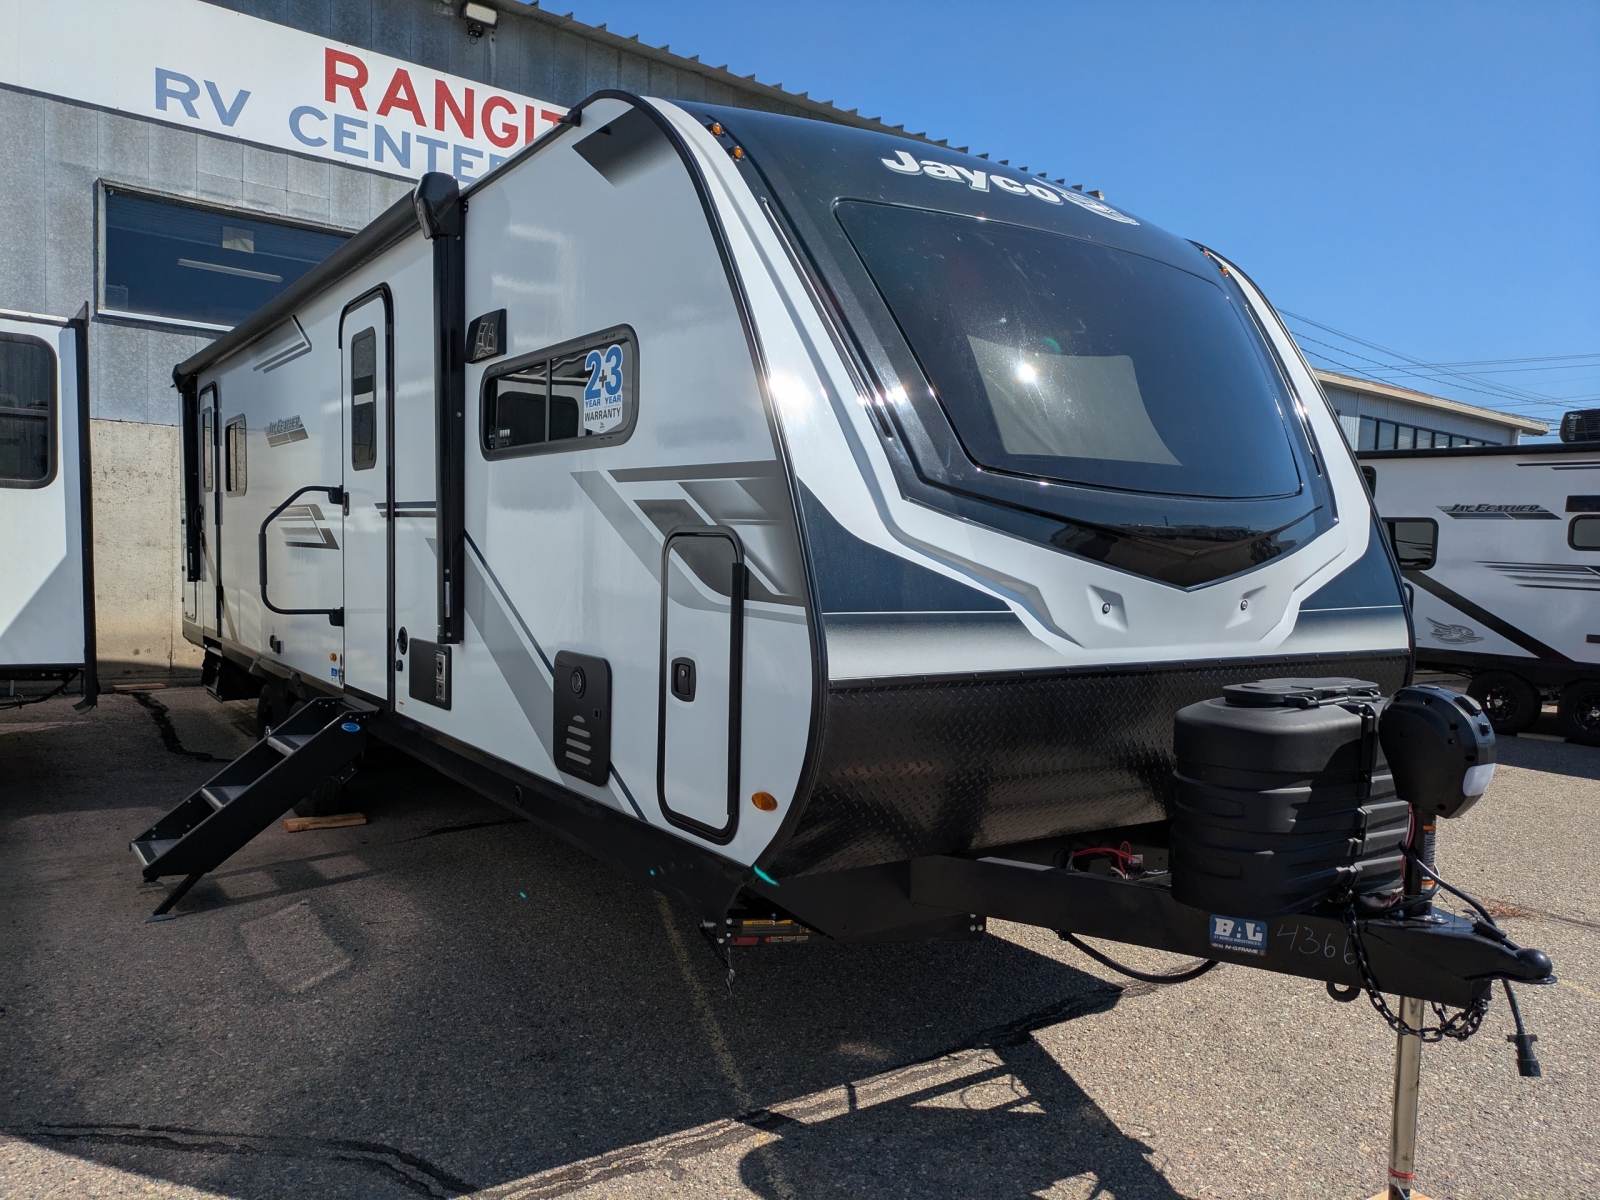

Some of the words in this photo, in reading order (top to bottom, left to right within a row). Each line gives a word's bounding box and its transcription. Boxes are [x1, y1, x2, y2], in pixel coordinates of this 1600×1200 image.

[154, 67, 252, 127] RV
[288, 105, 507, 184] CENTE
[881, 149, 1064, 206] Jayco
[585, 398, 601, 408] YEAR
[605, 395, 621, 404] YEAR
[585, 408, 621, 421] WARRANTY
